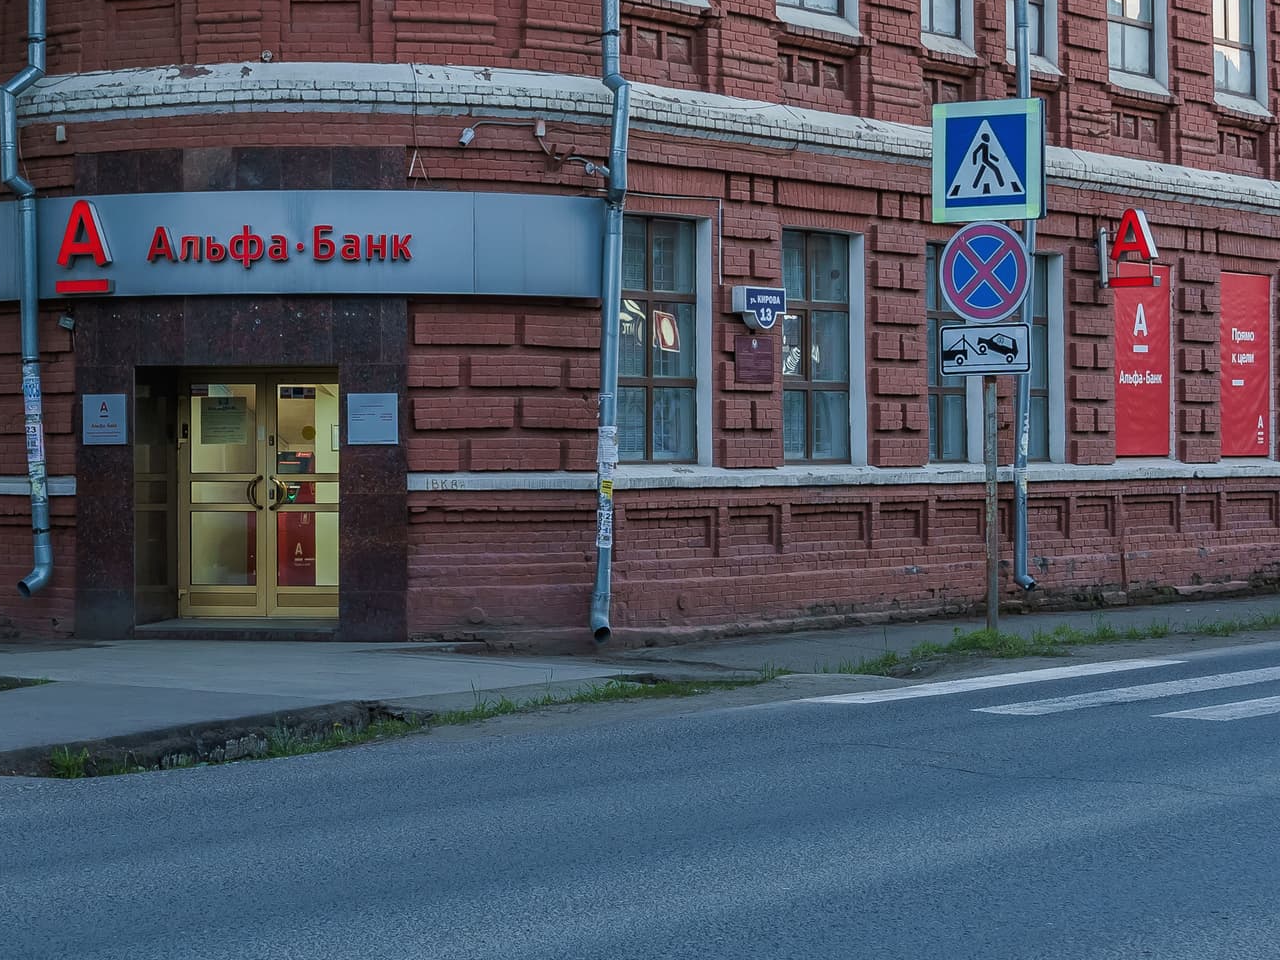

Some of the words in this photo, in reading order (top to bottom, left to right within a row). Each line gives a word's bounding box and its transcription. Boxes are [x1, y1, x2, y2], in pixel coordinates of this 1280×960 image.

[757, 296, 780, 304] КИРОВА
[760, 307, 772, 321] 13
[1231, 328, 1255, 343] Прямо
[1238, 353, 1255, 365] цели
